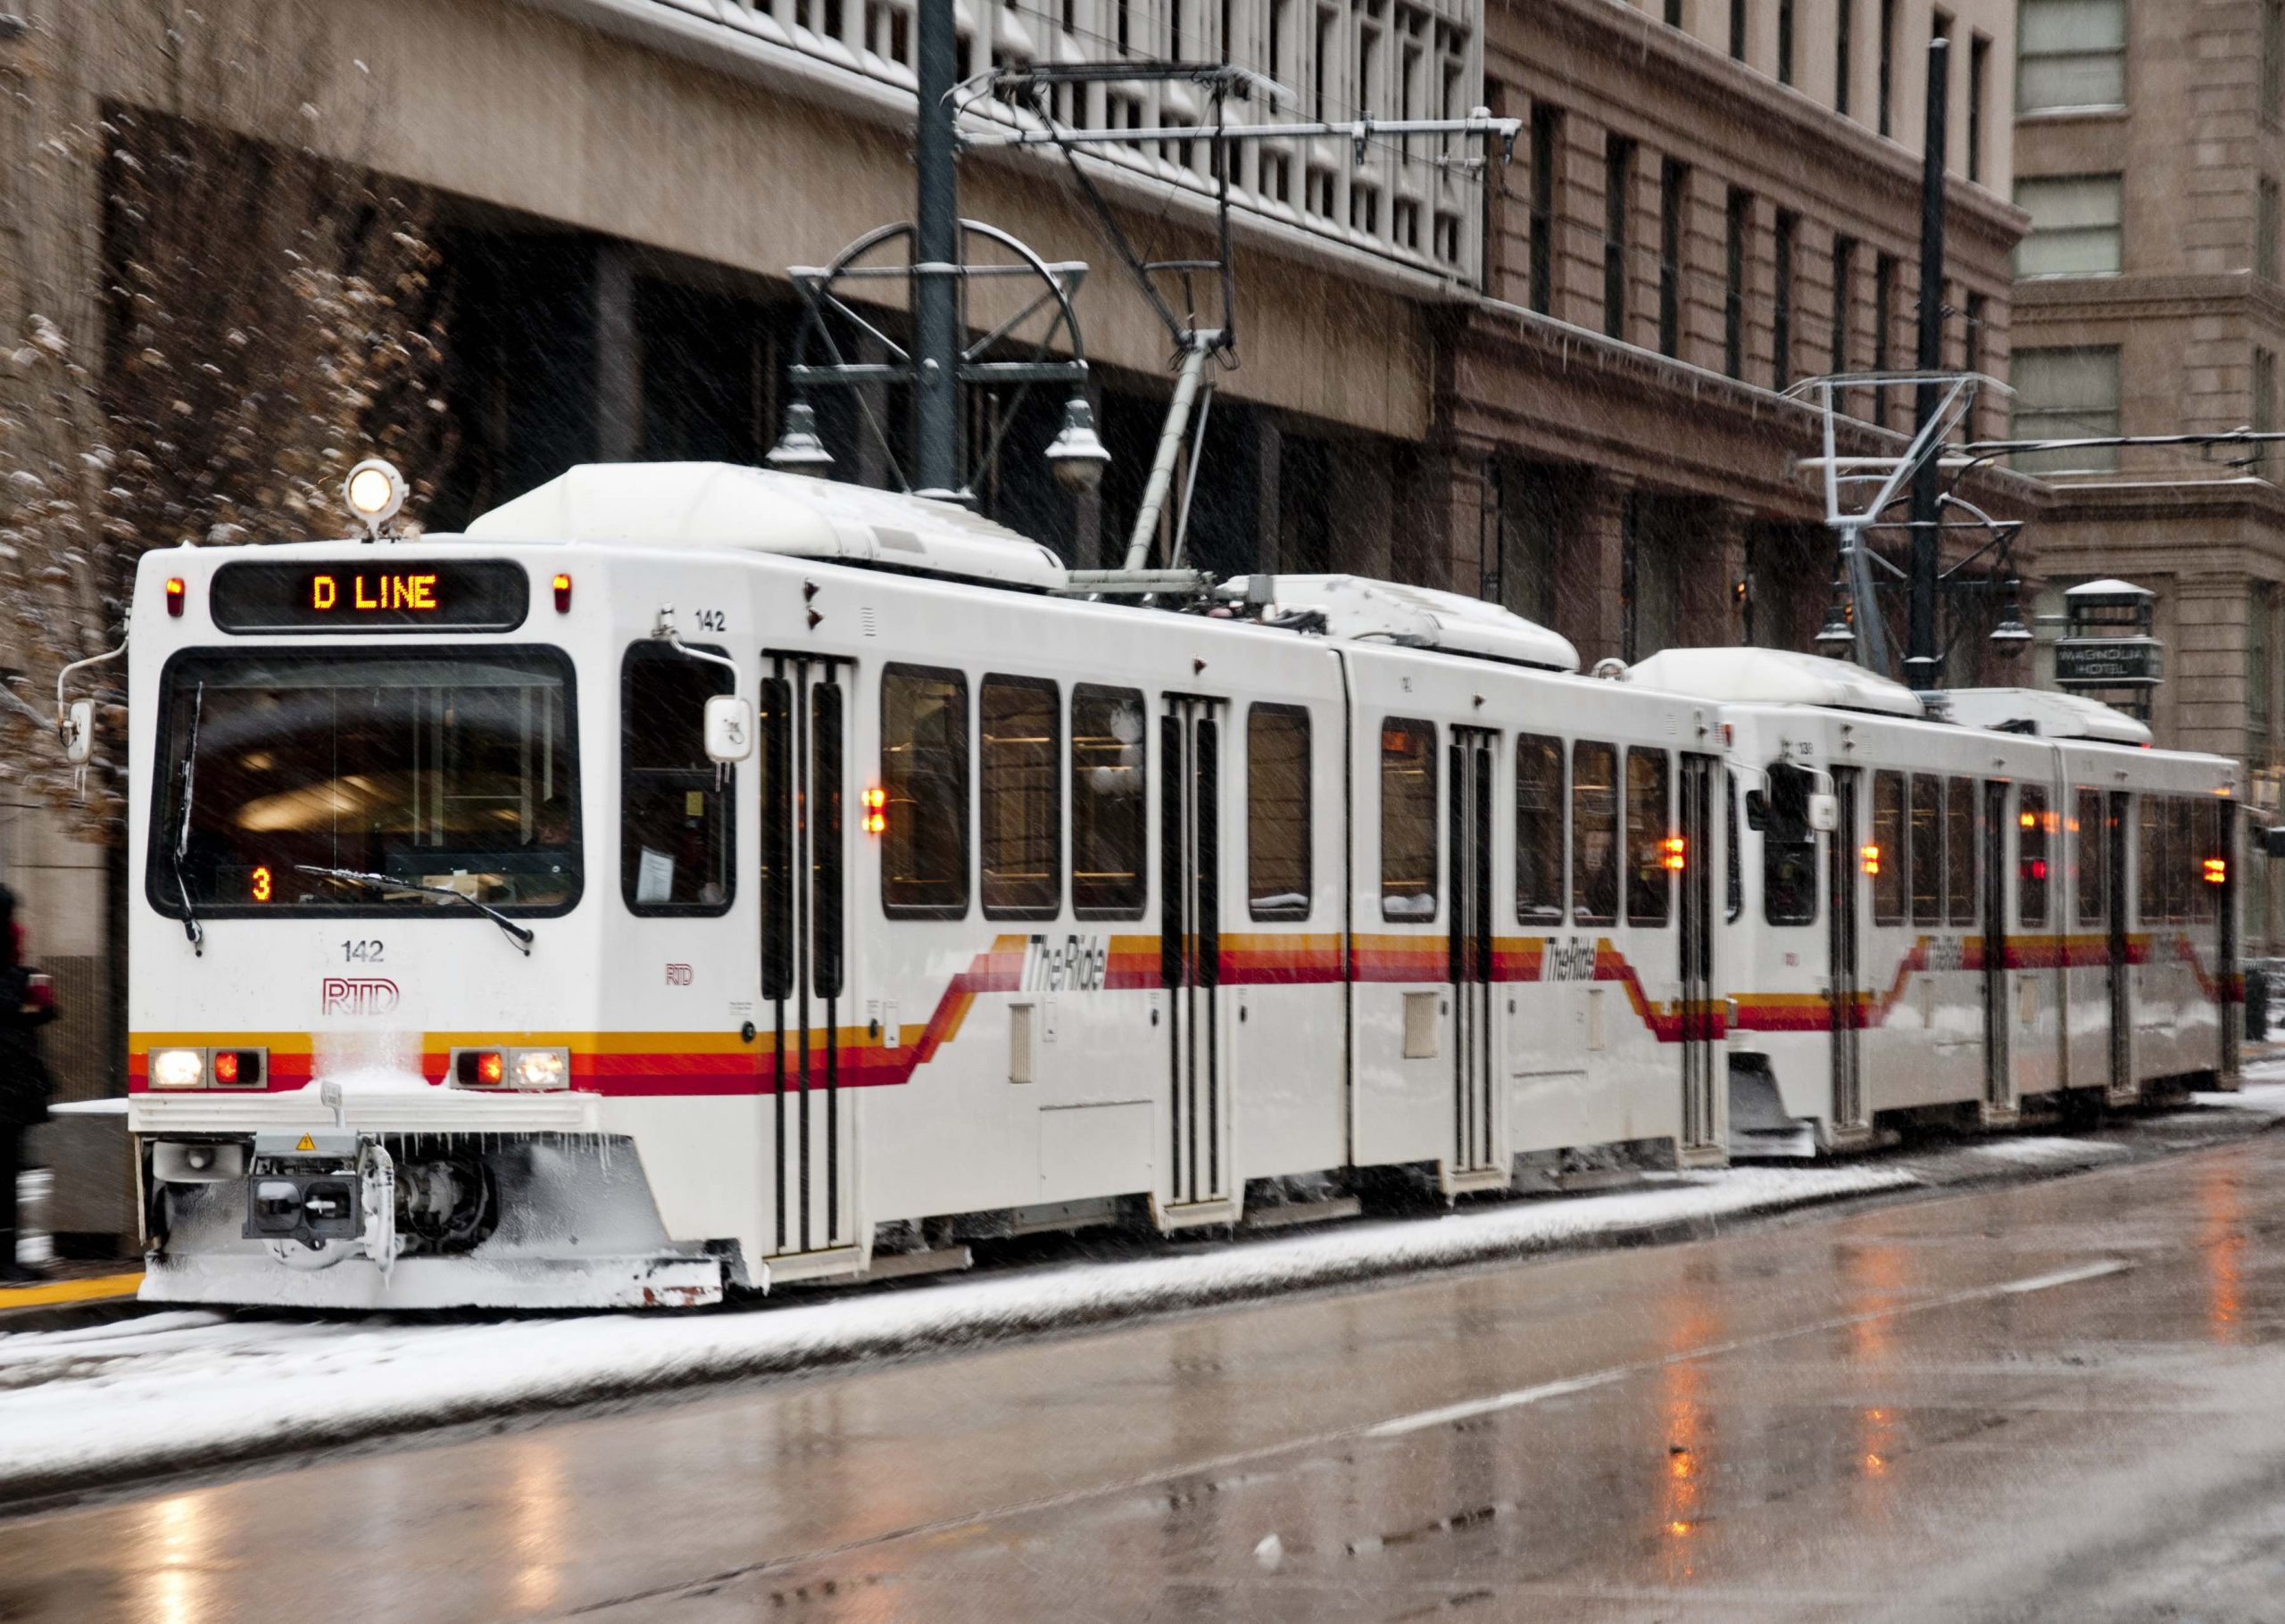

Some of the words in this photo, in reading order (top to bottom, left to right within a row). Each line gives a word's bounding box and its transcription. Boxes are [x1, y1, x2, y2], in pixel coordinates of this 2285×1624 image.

[314, 575, 336, 609] D
[355, 574, 436, 609] LINE
[694, 609, 727, 632] 142
[252, 866, 270, 901] 3
[340, 940, 385, 963] 142
[666, 963, 694, 986] RTD
[322, 977, 400, 1015] RTD
